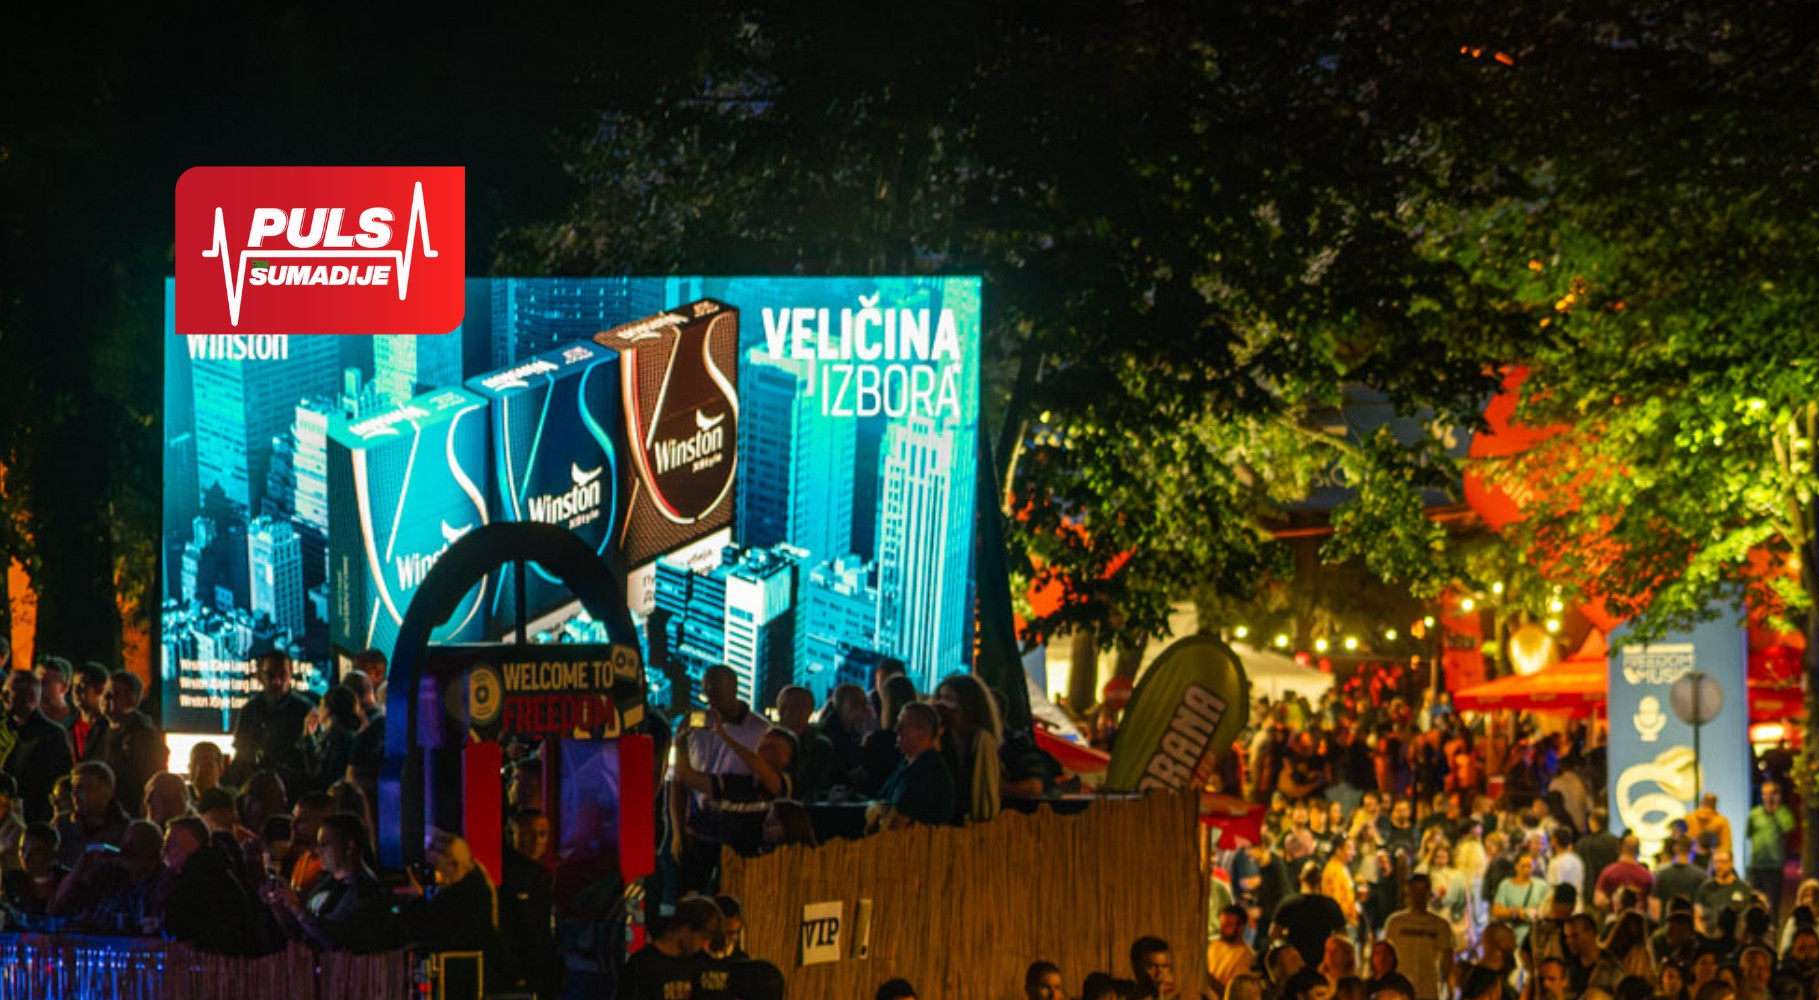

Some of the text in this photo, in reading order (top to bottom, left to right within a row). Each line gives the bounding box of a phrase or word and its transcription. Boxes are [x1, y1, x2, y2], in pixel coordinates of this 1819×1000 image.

[761, 295, 961, 360] VELIČINA
[821, 364, 961, 418] IZBORA
[654, 424, 725, 475] Winston
[527, 478, 601, 524] Winston
[396, 543, 448, 591] Win
[503, 661, 614, 690] WELCOME TO
[800, 917, 839, 949] VIP
